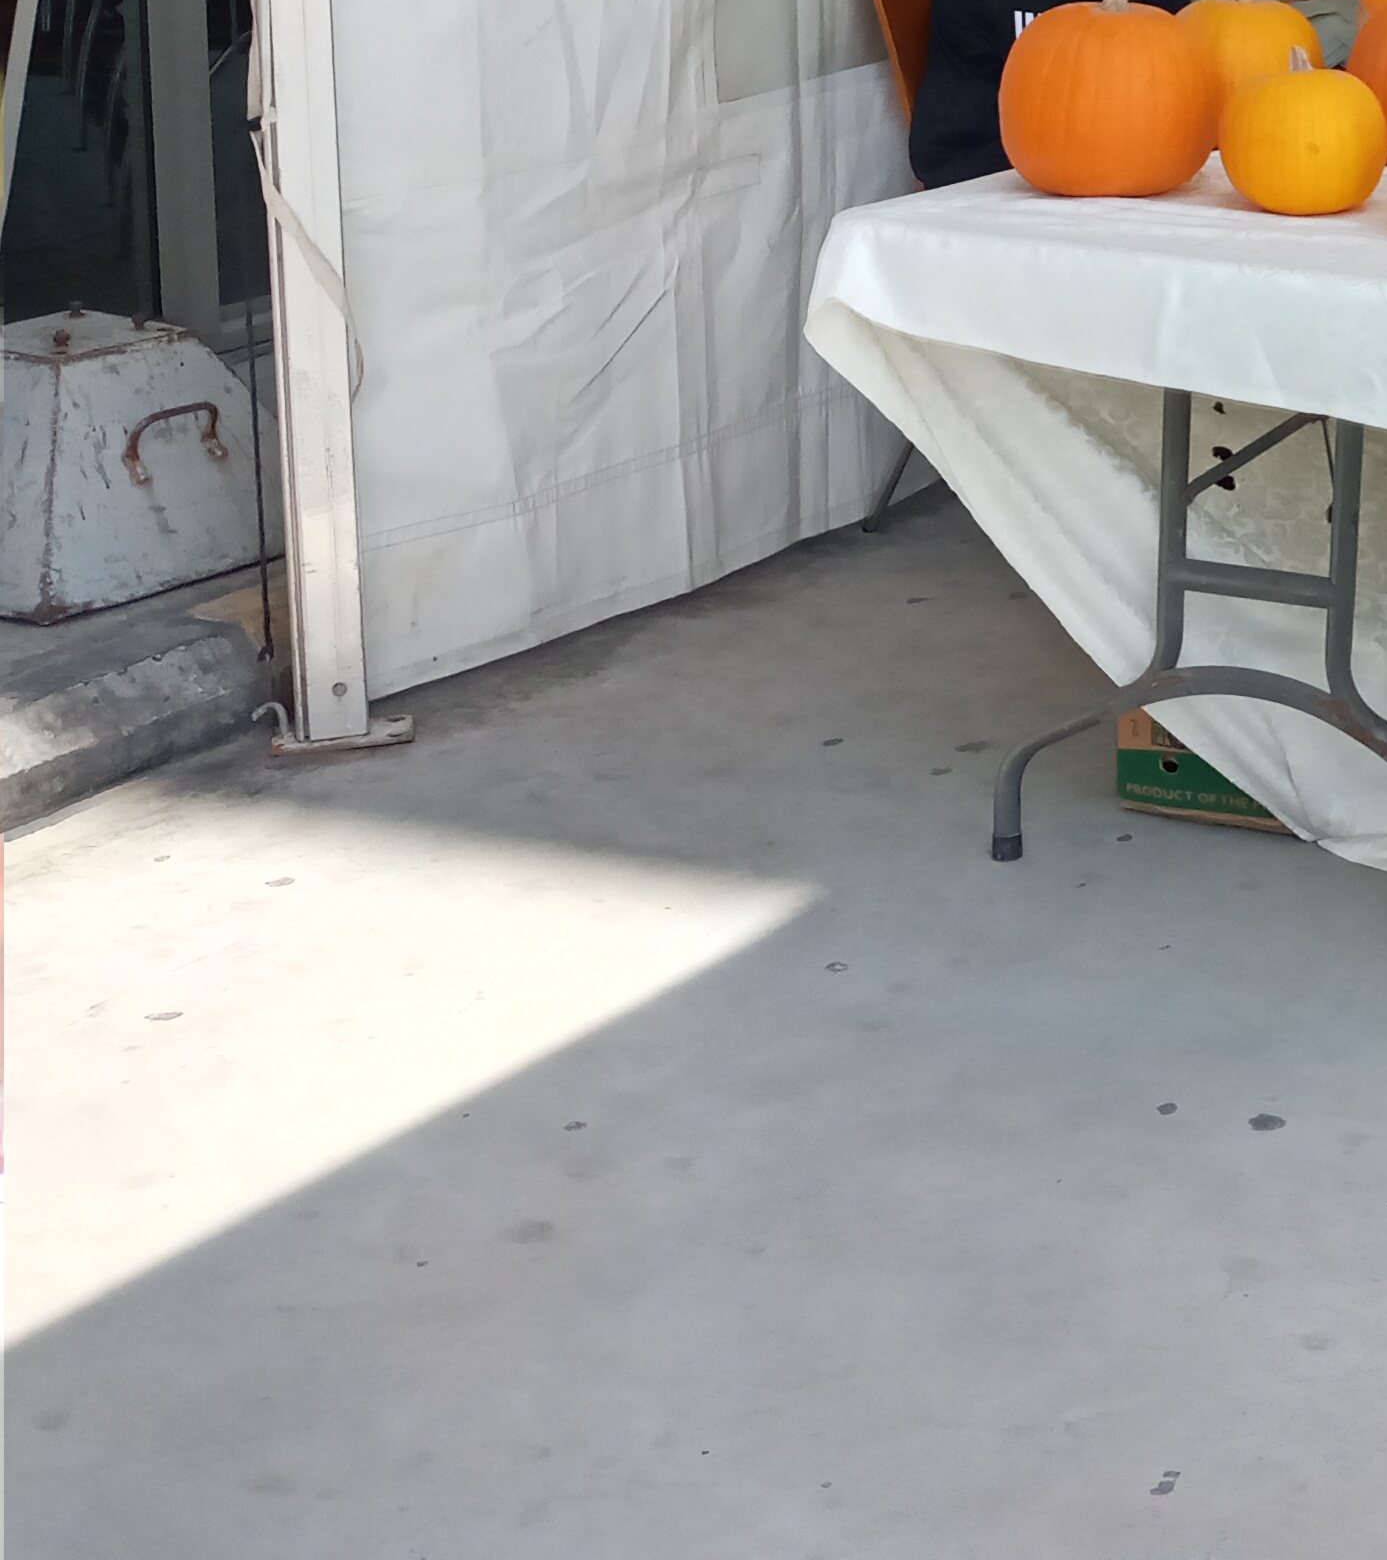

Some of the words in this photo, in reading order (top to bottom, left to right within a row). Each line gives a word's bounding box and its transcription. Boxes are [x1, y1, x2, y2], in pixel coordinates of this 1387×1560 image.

[1126, 782, 1193, 801] PRODUCT
[1198, 792, 1216, 805] OF
[1221, 795, 1249, 809] THE
